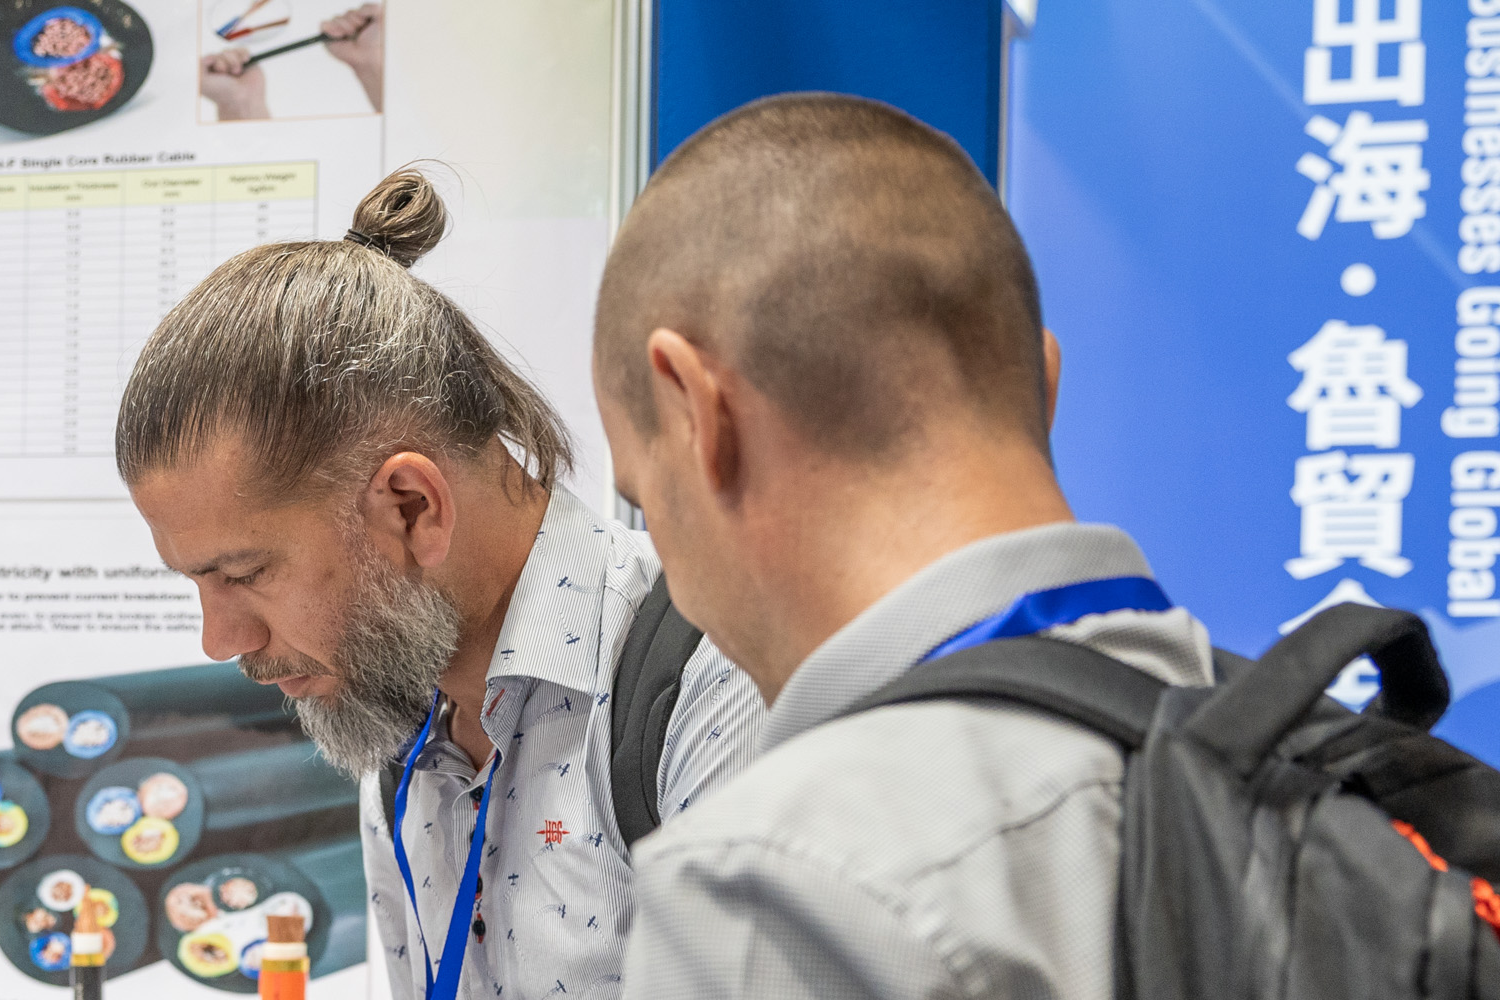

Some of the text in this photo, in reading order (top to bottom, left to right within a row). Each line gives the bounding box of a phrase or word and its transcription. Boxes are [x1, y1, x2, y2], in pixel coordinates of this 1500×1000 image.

[1441, 287, 1500, 438] Going
[59, 566, 97, 579] with
[1447, 451, 1500, 617] Global
